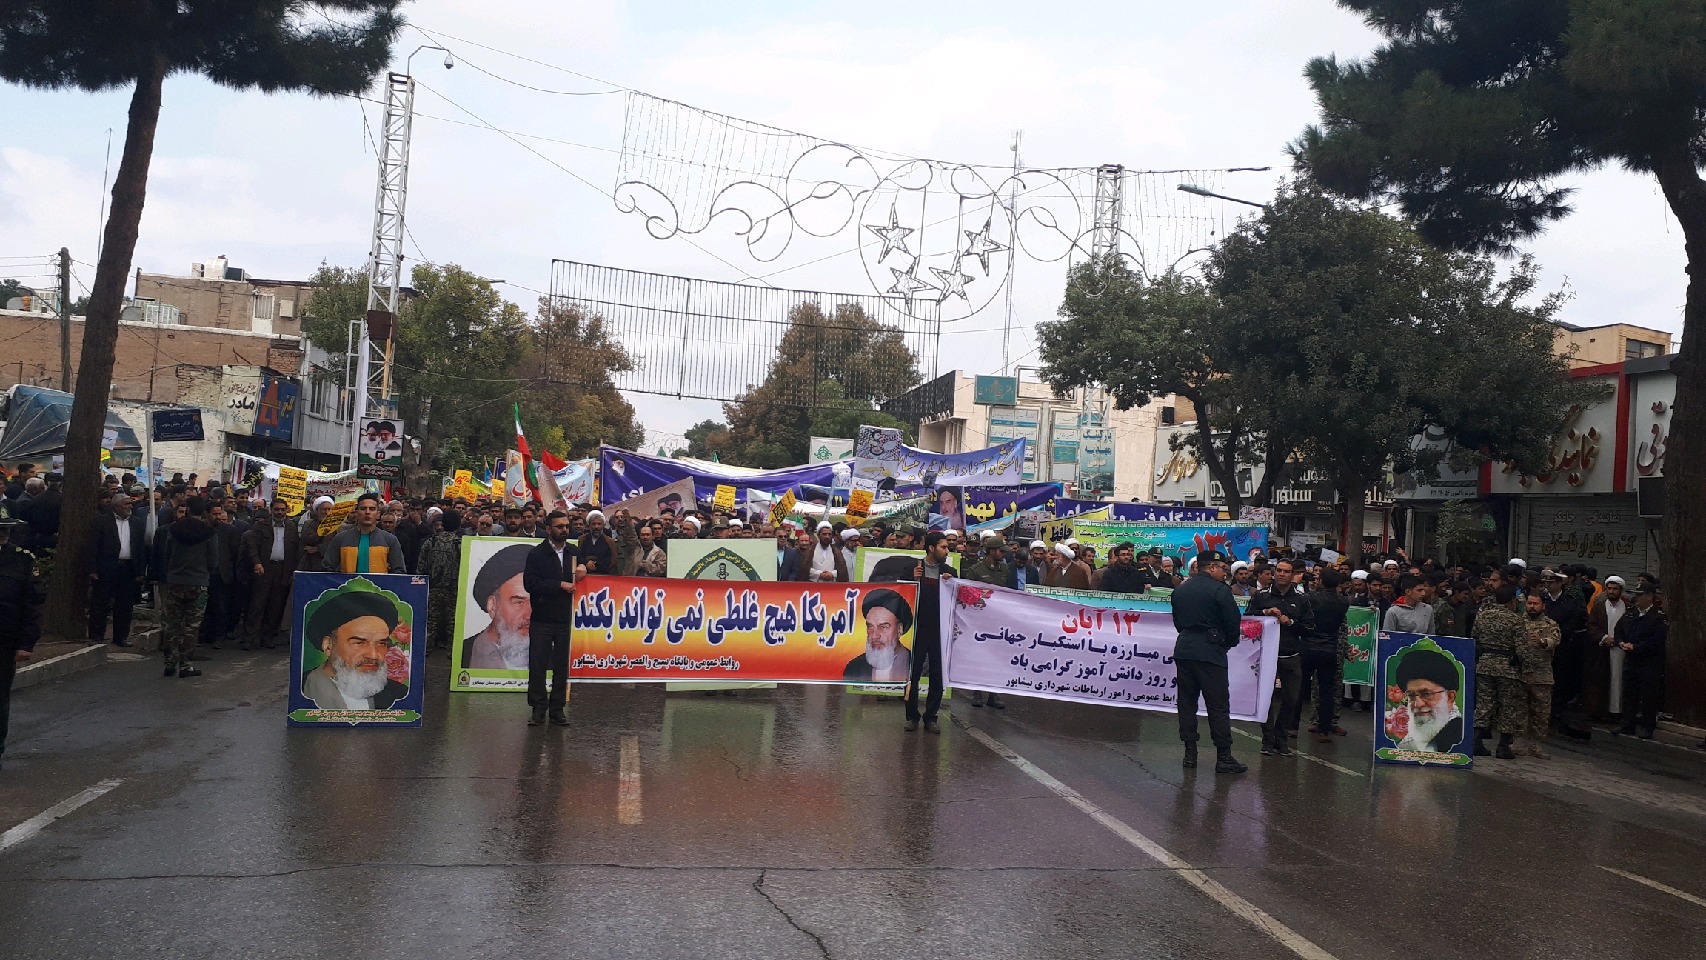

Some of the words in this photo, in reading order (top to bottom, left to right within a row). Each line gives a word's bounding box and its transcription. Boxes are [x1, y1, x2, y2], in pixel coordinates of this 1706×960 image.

[227, 396, 255, 410] مادر
[574, 587, 615, 642] بکند
[618, 587, 666, 644] تواند
[666, 588, 704, 645] نمی
[706, 588, 760, 645] غلطی
[763, 600, 796, 646] هیچ
[802, 588, 861, 648] آمریکا
[1061, 607, 1106, 635] آبان
[1113, 612, 1140, 636] ۱۳
[1353, 621, 1370, 637] این
[974, 627, 1027, 647] جهانی
[1028, 632, 1086, 651] استکبار
[1088, 638, 1108, 657] با
[1110, 643, 1159, 661] مبارزه
[572, 655, 596, 668] نیشابور
[597, 656, 628, 670] شهرداری
[652, 659, 670, 669] بسیج
[695, 659, 718, 669] عمومی
[719, 656, 740, 671] روابط
[1010, 653, 1029, 671] باد
[1031, 658, 1074, 676] گرامی
[1074, 661, 1107, 679] آموز
[1005, 676, 1033, 688] نیشابور
[1108, 666, 1143, 682] دانش
[1145, 671, 1167, 687] روز
[1034, 680, 1071, 692] شهرداری
[1107, 689, 1126, 699] امور
[1133, 694, 1160, 702] عمومی
